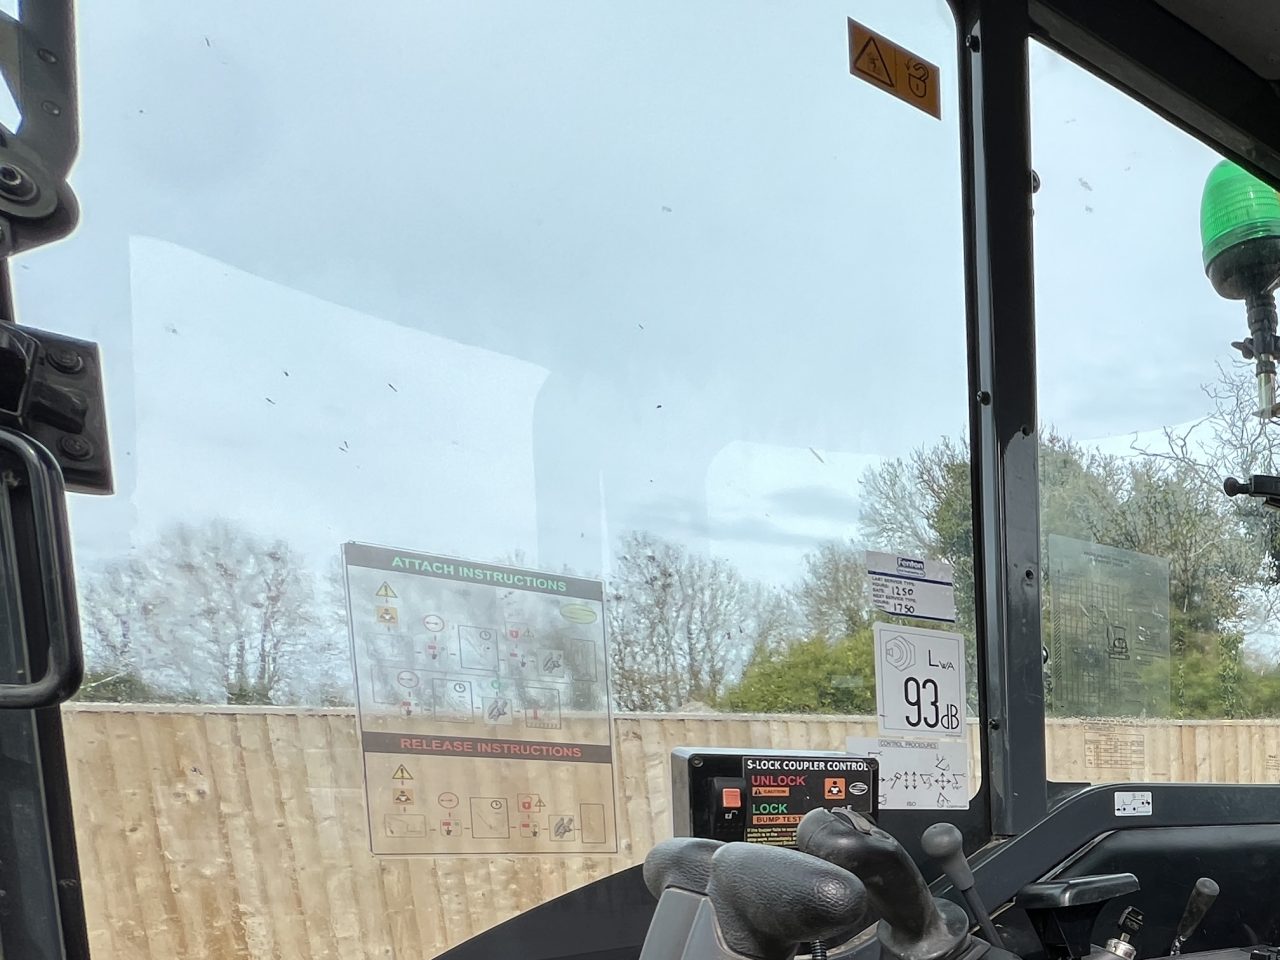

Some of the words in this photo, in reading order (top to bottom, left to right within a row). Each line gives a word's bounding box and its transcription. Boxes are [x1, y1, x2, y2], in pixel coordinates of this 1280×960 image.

[392, 556, 454, 575] ATTACH
[459, 566, 567, 592] INSTRUCTIONS
[892, 586, 914, 596] 1250
[894, 603, 915, 614] 1750
[904, 676, 939, 728] 93
[941, 704, 959, 730] dB
[401, 738, 473, 752] RELEASE
[477, 742, 582, 758] INSTRUCTIONS
[747, 759, 781, 770] S-LOCK
[783, 761, 825, 771] COUPLER
[827, 761, 869, 771] CONTROL
[751, 775, 806, 786] UNLOCK
[752, 803, 788, 814] LOCK
